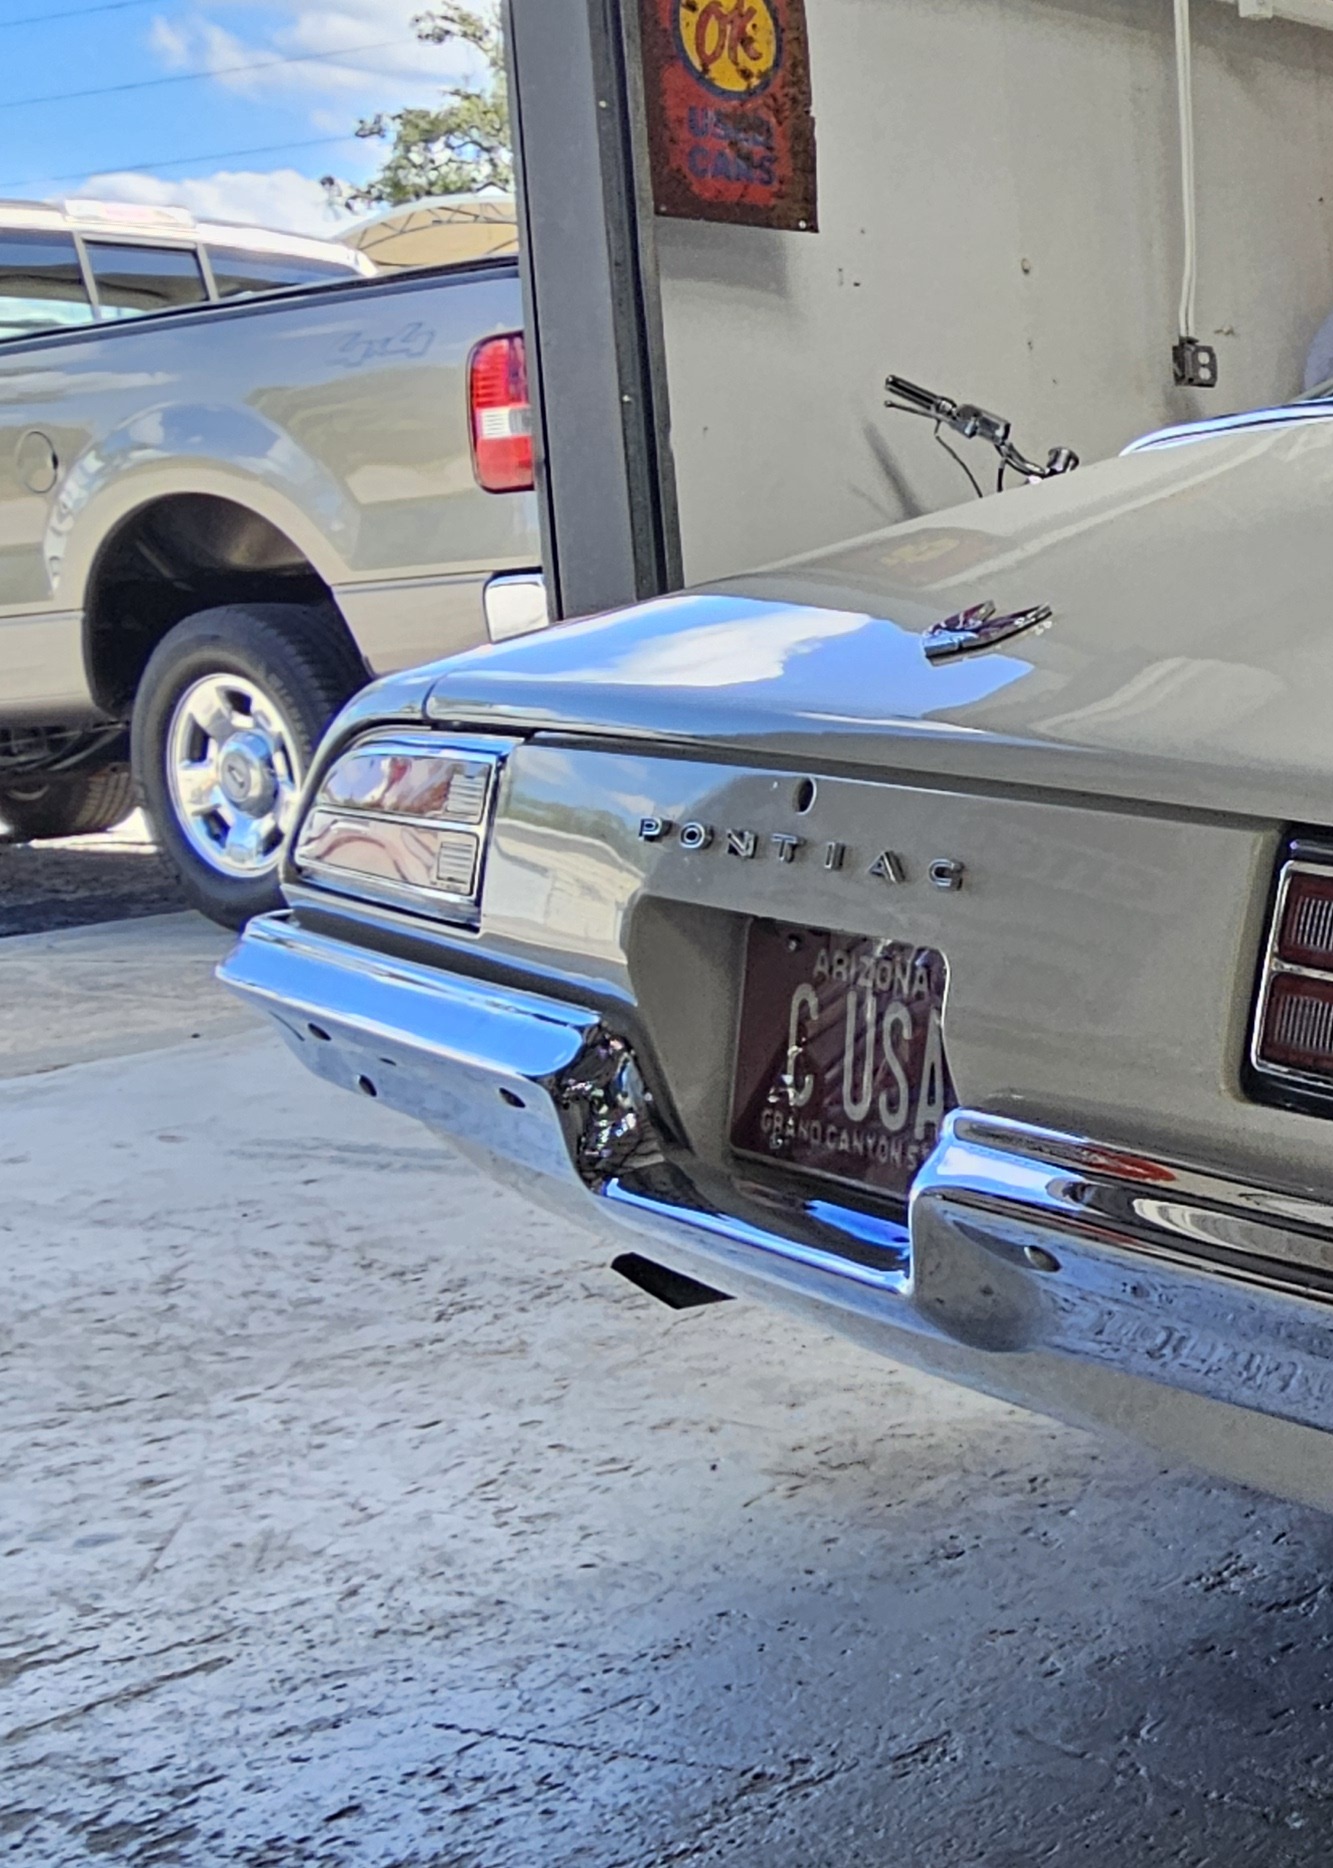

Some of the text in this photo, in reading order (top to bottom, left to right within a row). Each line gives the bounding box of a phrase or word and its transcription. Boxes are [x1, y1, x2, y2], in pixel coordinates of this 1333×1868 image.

[695, 0, 764, 66] OK
[638, 816, 967, 890] PONTIAC
[812, 948, 930, 996] ARIZONA
[825, 1123, 902, 1164] CANYON
